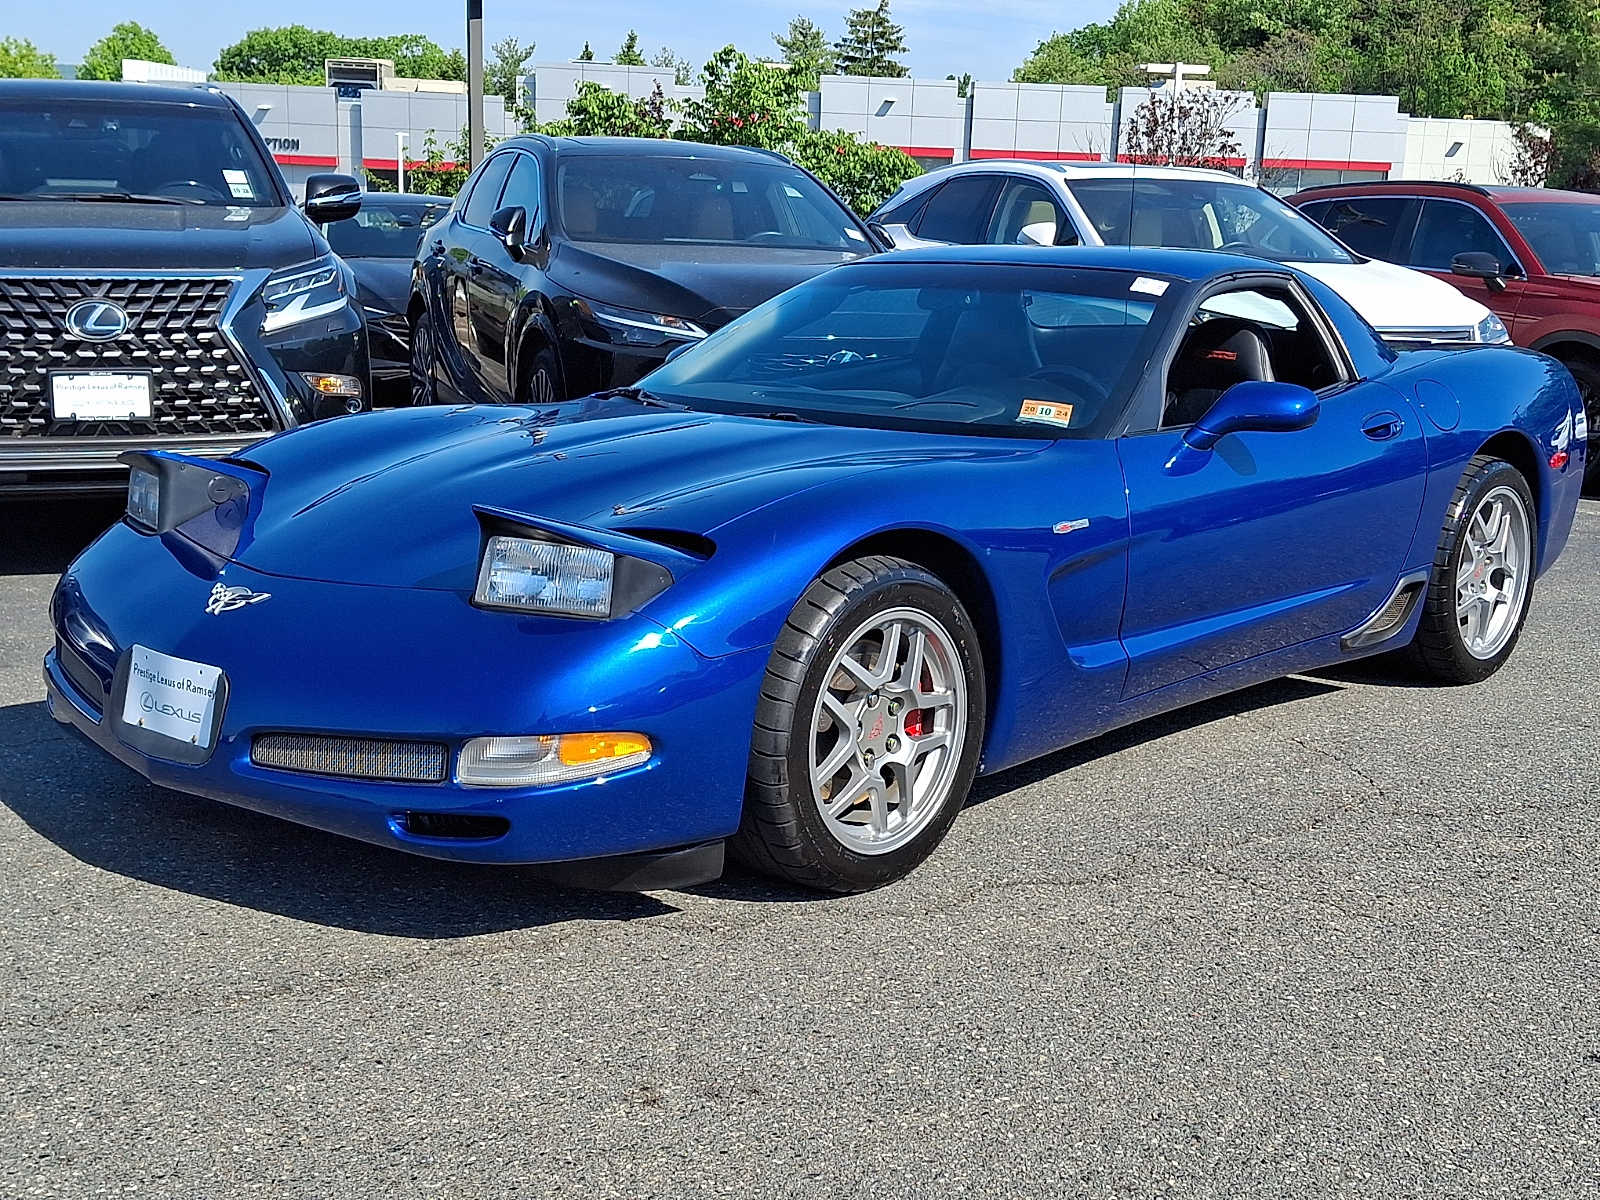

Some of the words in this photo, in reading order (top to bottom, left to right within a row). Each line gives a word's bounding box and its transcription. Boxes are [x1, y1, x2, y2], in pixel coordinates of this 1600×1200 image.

[1039, 407, 1052, 416] 10
[133, 662, 156, 683] Prestige
[157, 671, 176, 687] Lexus
[176, 677, 185, 690] of
[186, 679, 215, 700] Ramsey
[154, 700, 202, 724] LEXUS
